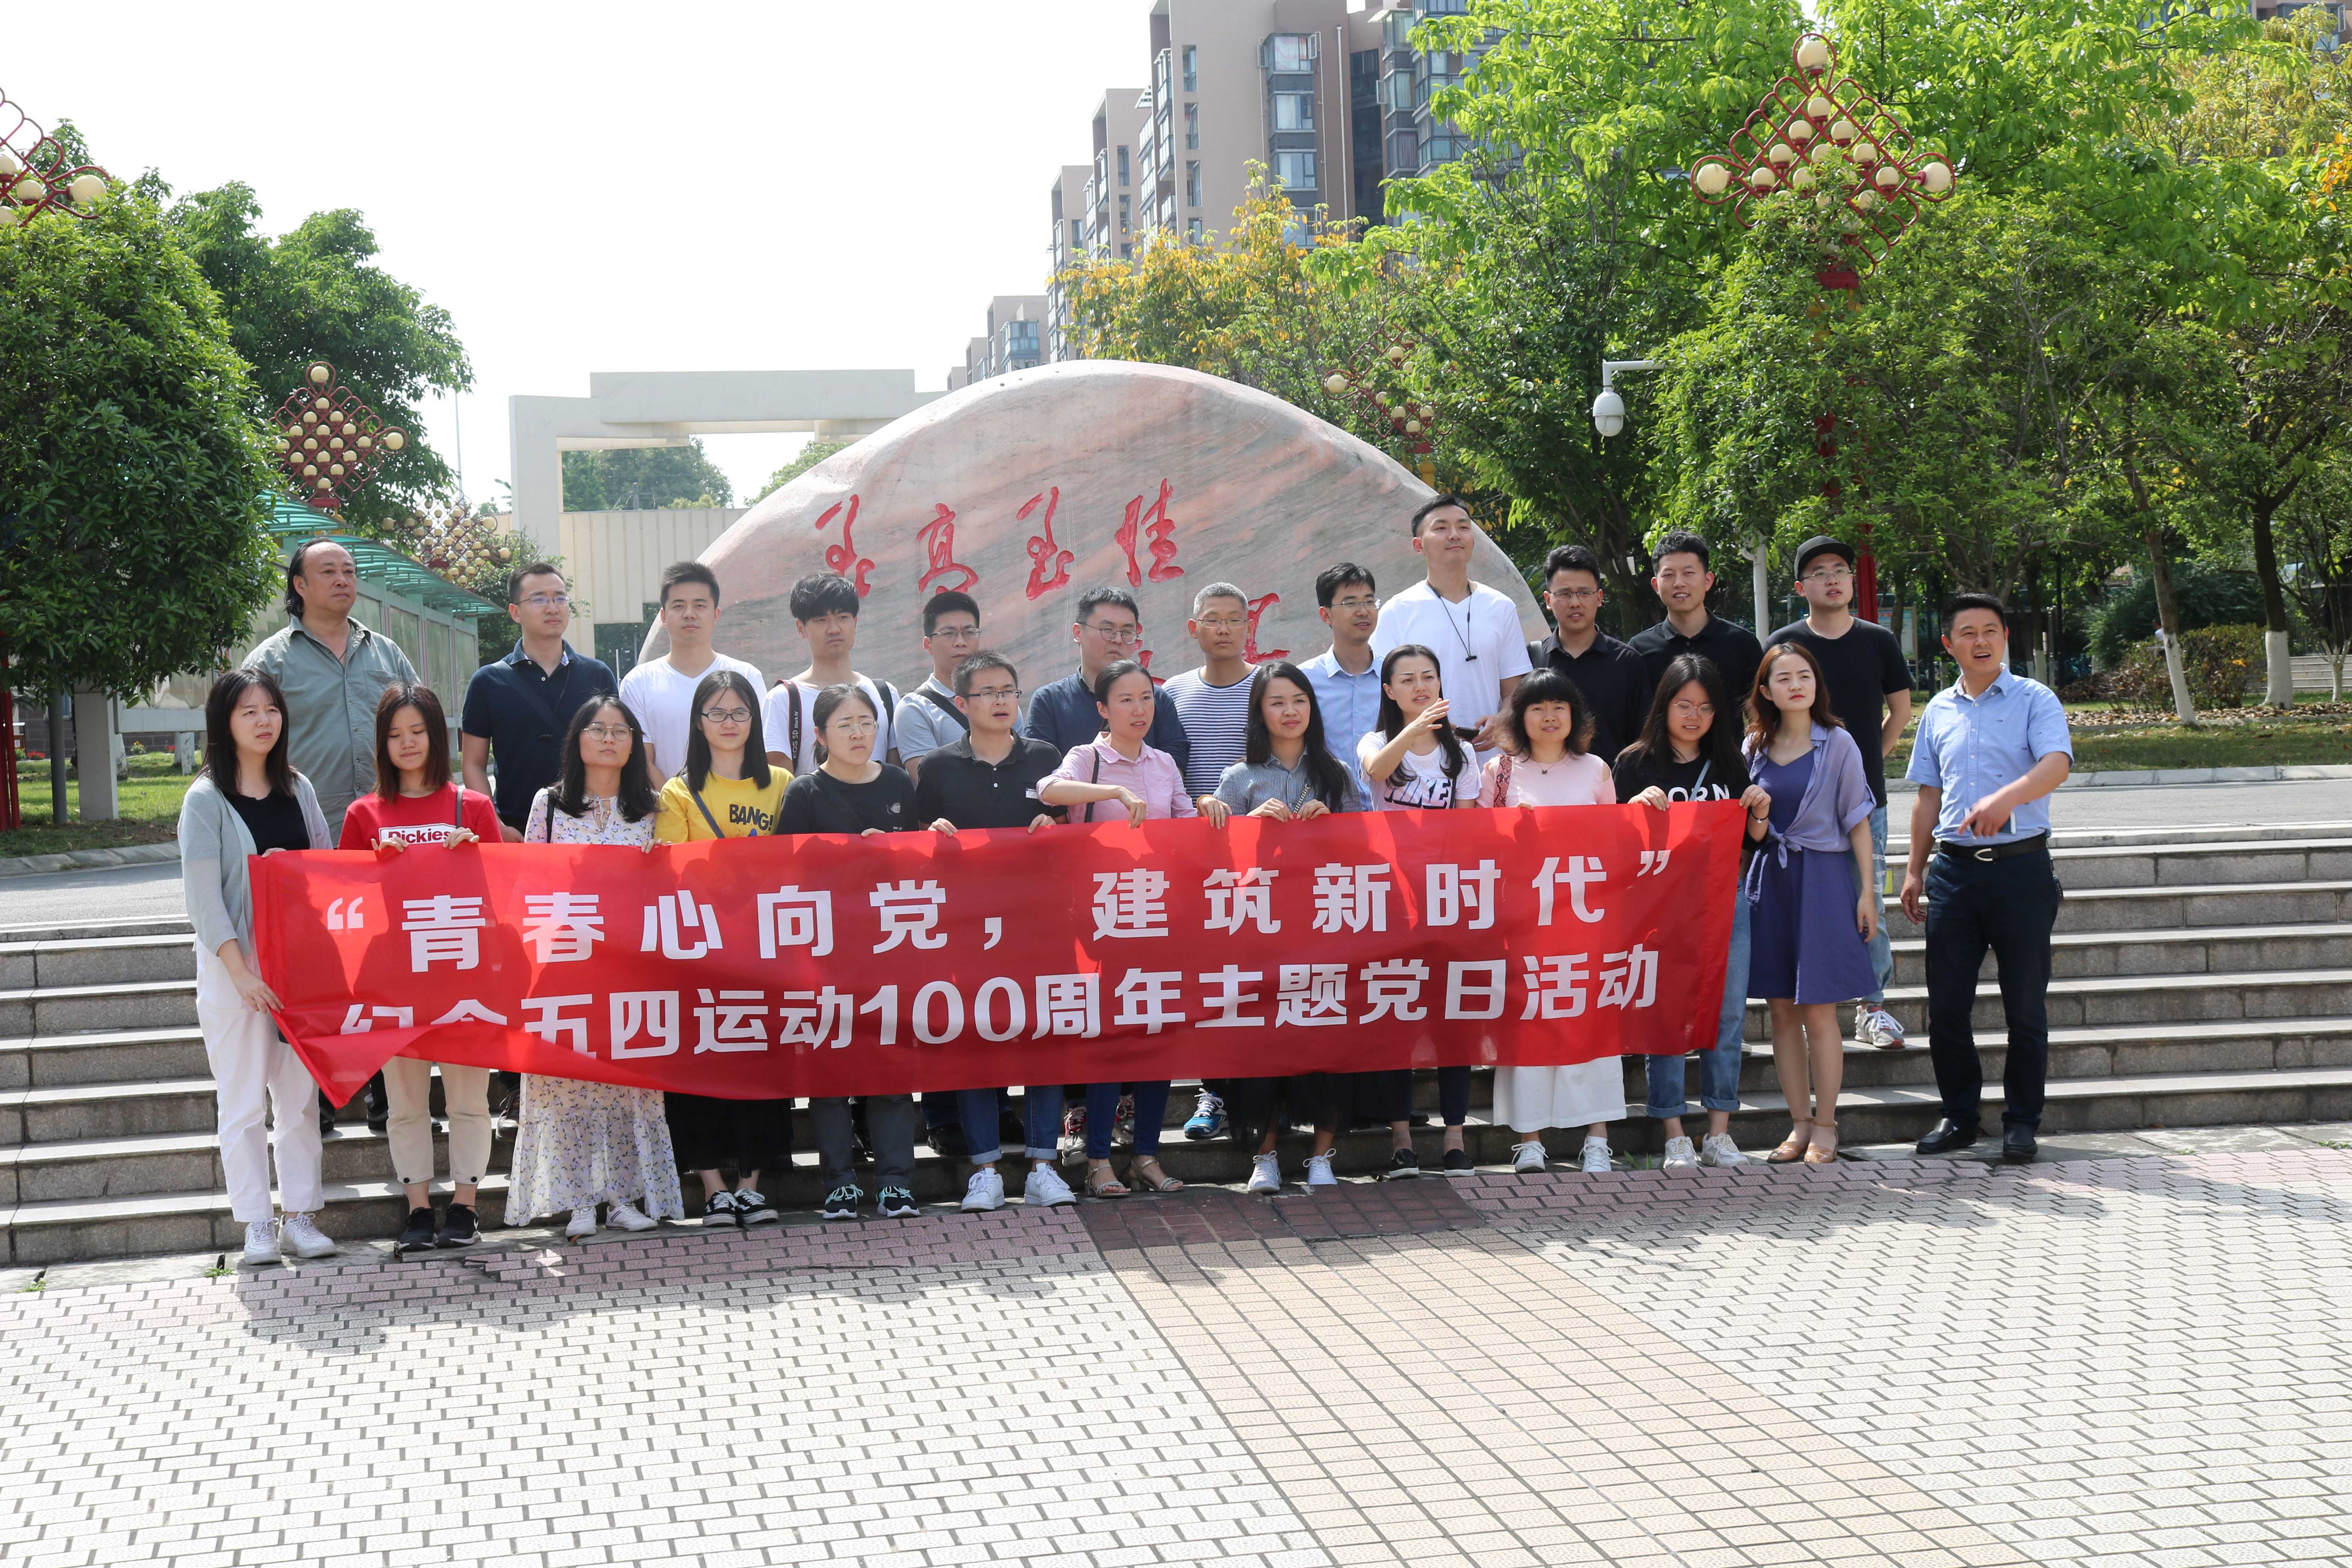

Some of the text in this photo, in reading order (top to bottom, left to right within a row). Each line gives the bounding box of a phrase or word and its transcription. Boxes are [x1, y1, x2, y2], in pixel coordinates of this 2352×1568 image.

[792, 730, 799, 739] 5D
[729, 804, 773, 831] BANG!
[388, 828, 452, 844] Dickies
